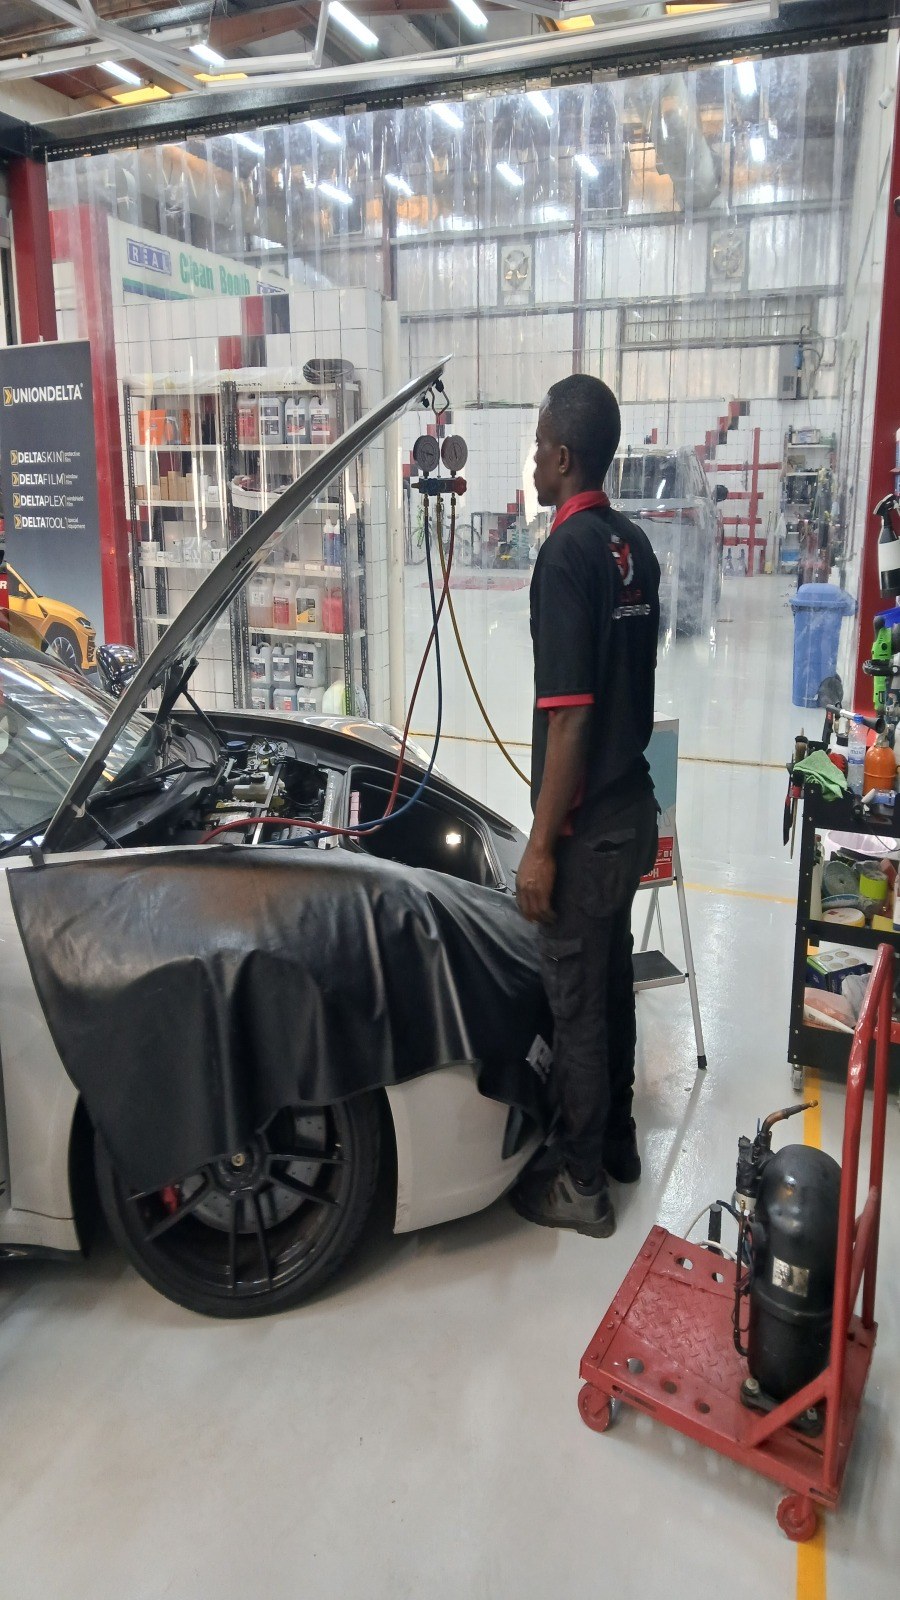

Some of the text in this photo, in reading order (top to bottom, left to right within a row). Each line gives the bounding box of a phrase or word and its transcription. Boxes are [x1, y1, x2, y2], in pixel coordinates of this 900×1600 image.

[132, 247, 168, 269] REAL
[179, 252, 250, 296] Clean Booth
[12, 384, 82, 403] UNIONDELTA
[18, 451, 61, 463] DELTASKIN
[20, 473, 64, 485] DELTAFILM
[20, 495, 65, 507] DELTAPLEX
[22, 517, 65, 529] DELTATOOL
